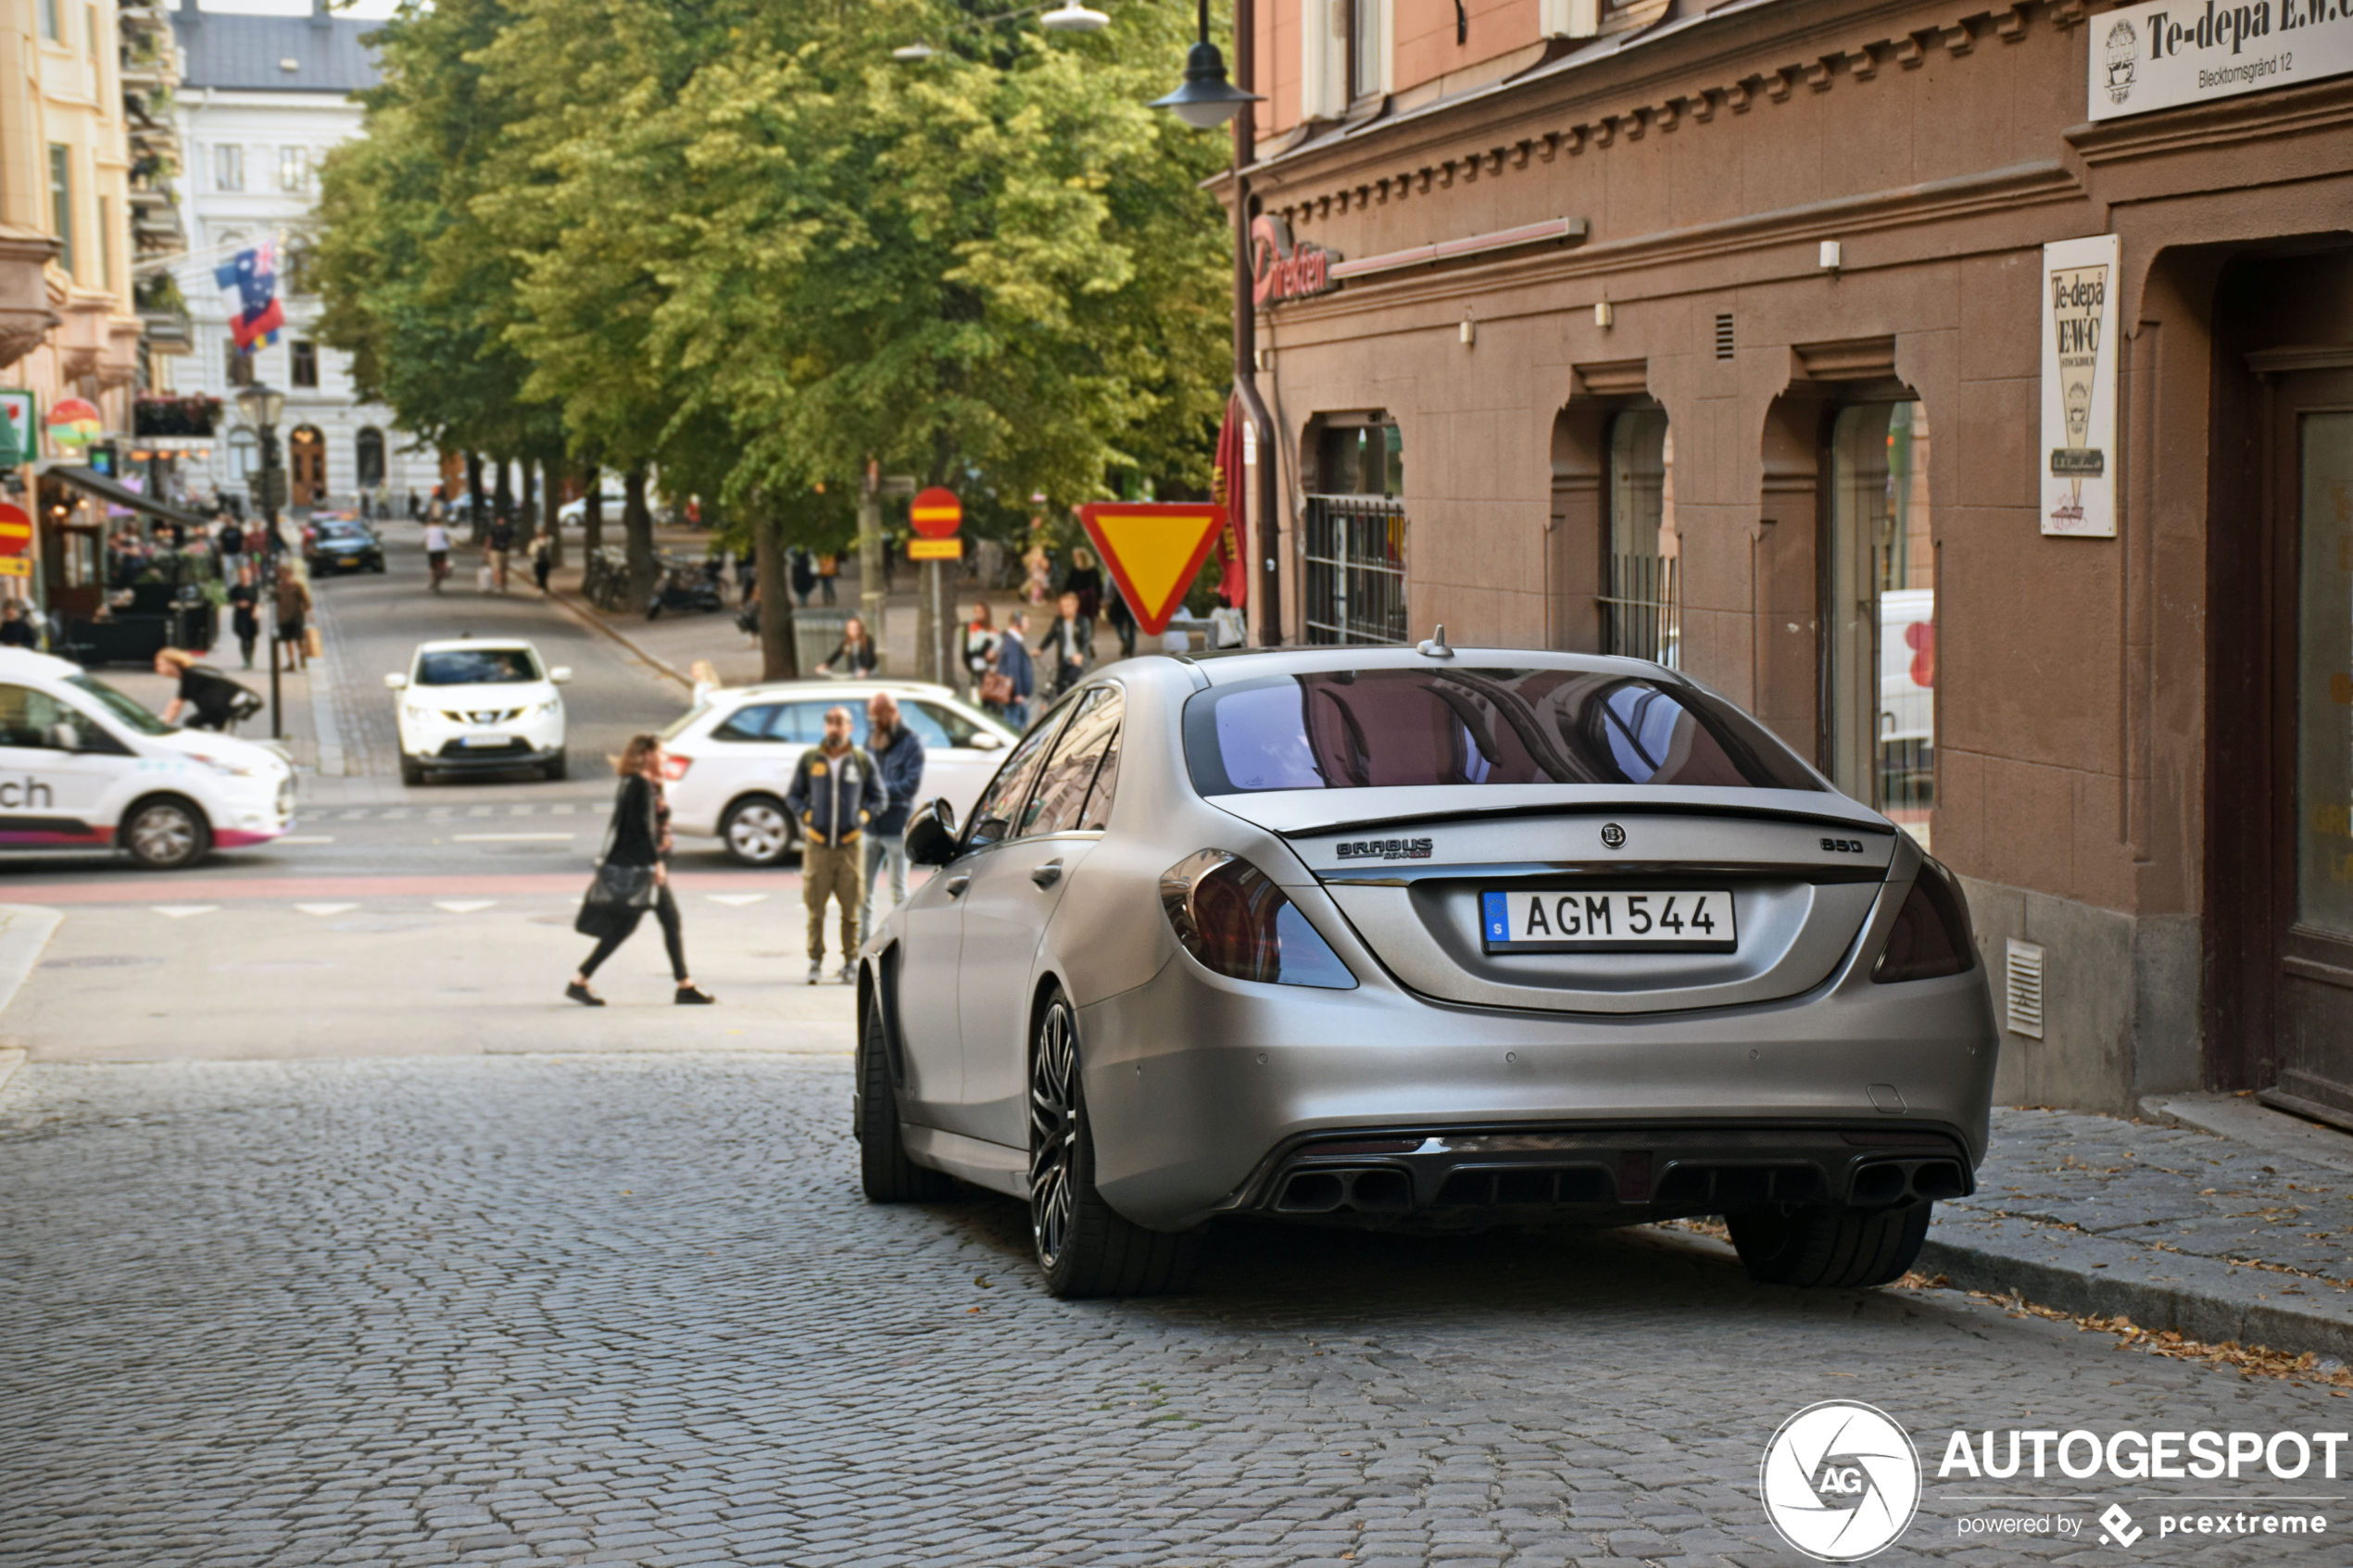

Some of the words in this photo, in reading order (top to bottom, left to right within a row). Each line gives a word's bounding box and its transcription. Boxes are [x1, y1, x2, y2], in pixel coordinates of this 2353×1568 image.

[2198, 60, 2277, 89] Blecktornsgränd
[2280, 51, 2293, 72] 12
[1252, 214, 1326, 307] Direkten
[2052, 271, 2104, 316] Te-depå
[1337, 837, 1433, 855] BRABUS
[1604, 827, 1623, 842] B
[1493, 922, 1503, 935] S
[1526, 896, 1612, 935] AGM
[1627, 896, 1715, 935] 544
